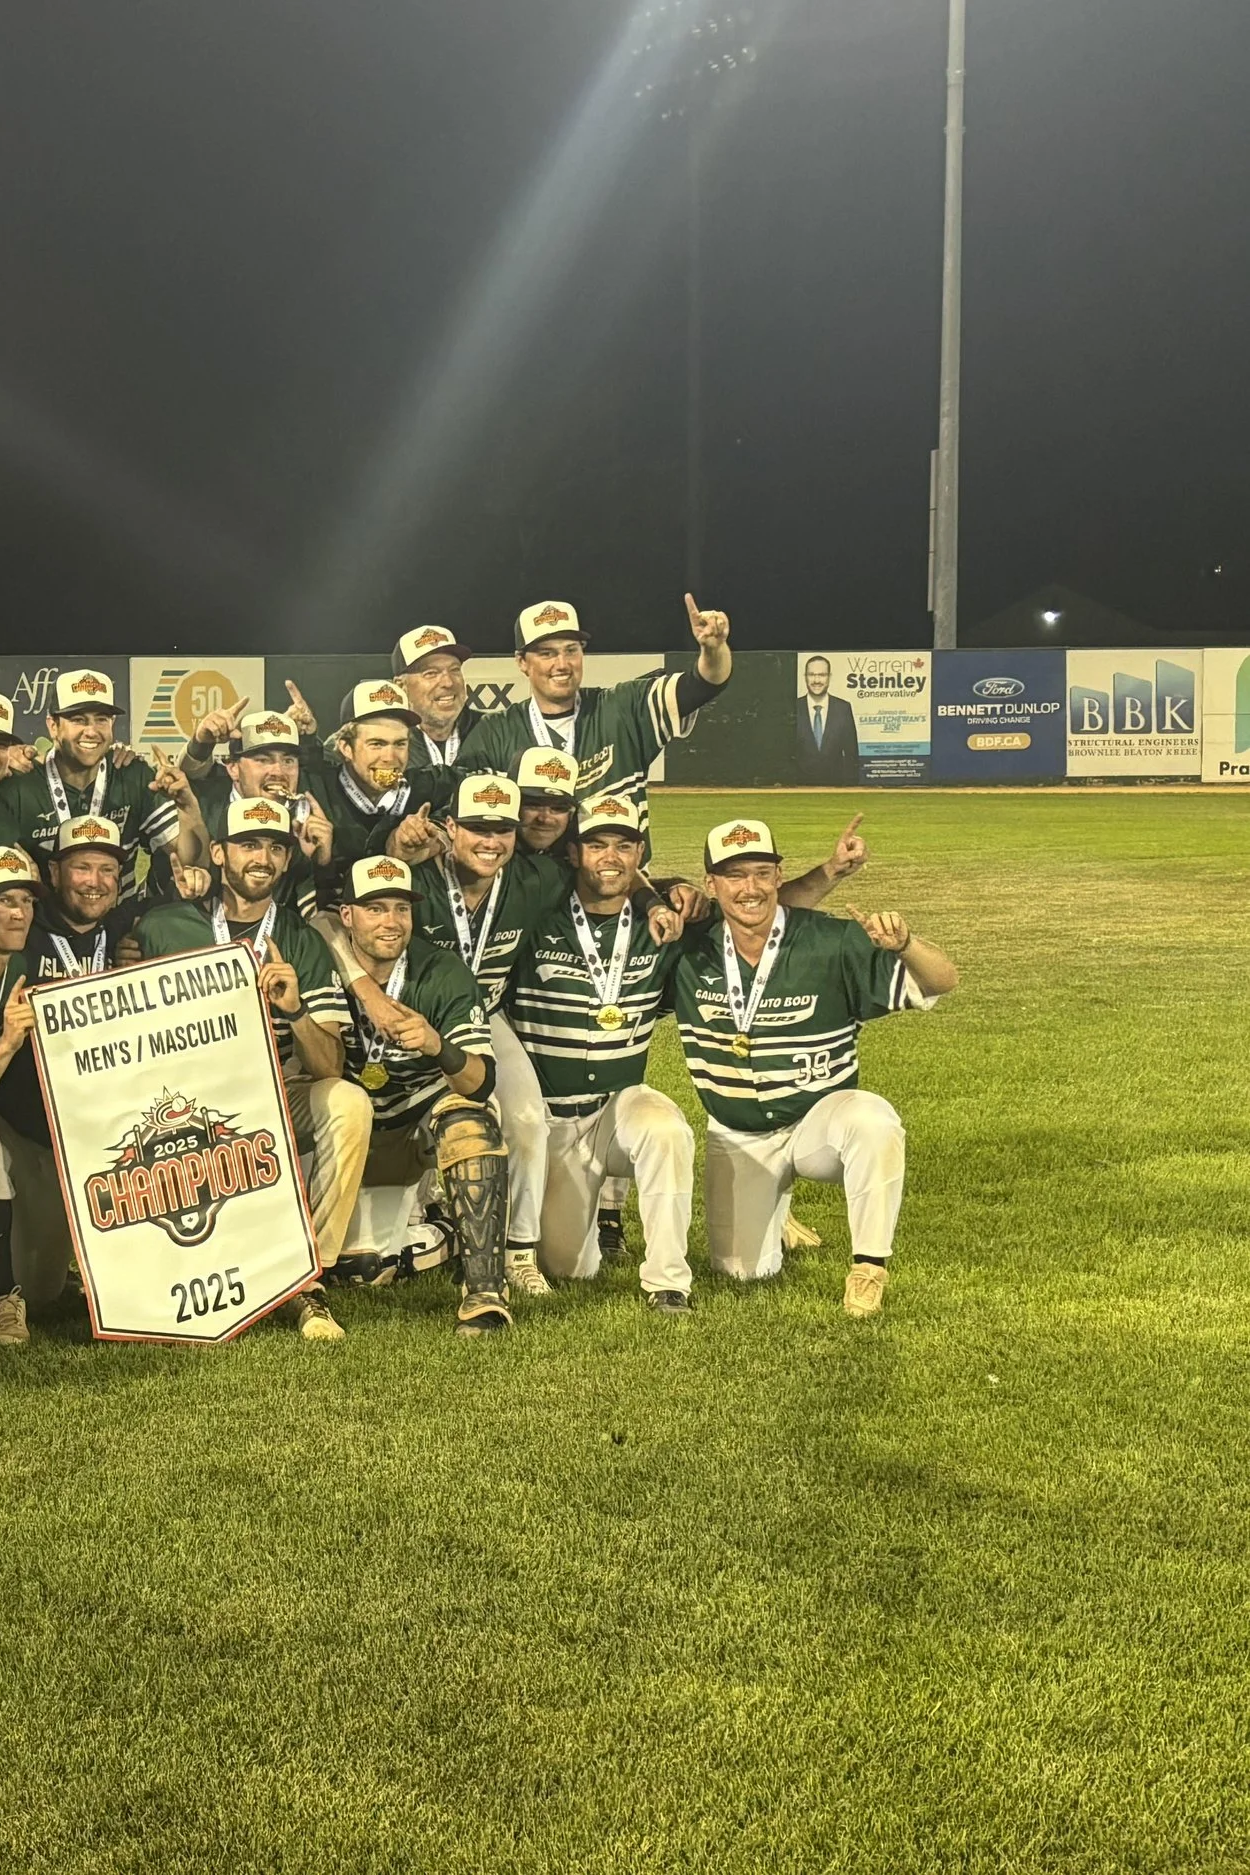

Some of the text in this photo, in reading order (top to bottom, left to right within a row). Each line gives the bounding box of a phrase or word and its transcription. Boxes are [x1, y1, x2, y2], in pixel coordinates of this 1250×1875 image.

[847, 657, 912, 673] Warren
[846, 673, 927, 692] Steinley
[982, 681, 1016, 695] Ford
[191, 686, 222, 717] 50
[857, 690, 917, 699] Conservative
[938, 703, 1060, 716] BENNETT DUNLOP
[999, 716, 1031, 724] CHANGE
[976, 736, 1021, 747] BDF.CA
[1068, 738, 1199, 747] STRUCTURAL ENGINEERS
[1068, 749, 1121, 757] BROWNLEE
[629, 953, 659, 967] BODY
[43, 980, 157, 1035] BASEBALL
[158, 958, 249, 1006] CANADA
[759, 998, 782, 1008] UTO
[783, 995, 818, 1007] BODY
[74, 1013, 238, 1075] MEN'S / MASCULIN
[792, 1050, 830, 1085] 39
[154, 1135, 198, 1158] 2025
[87, 1132, 278, 1229] CHAMPIONS
[171, 1267, 245, 1323] 2025
